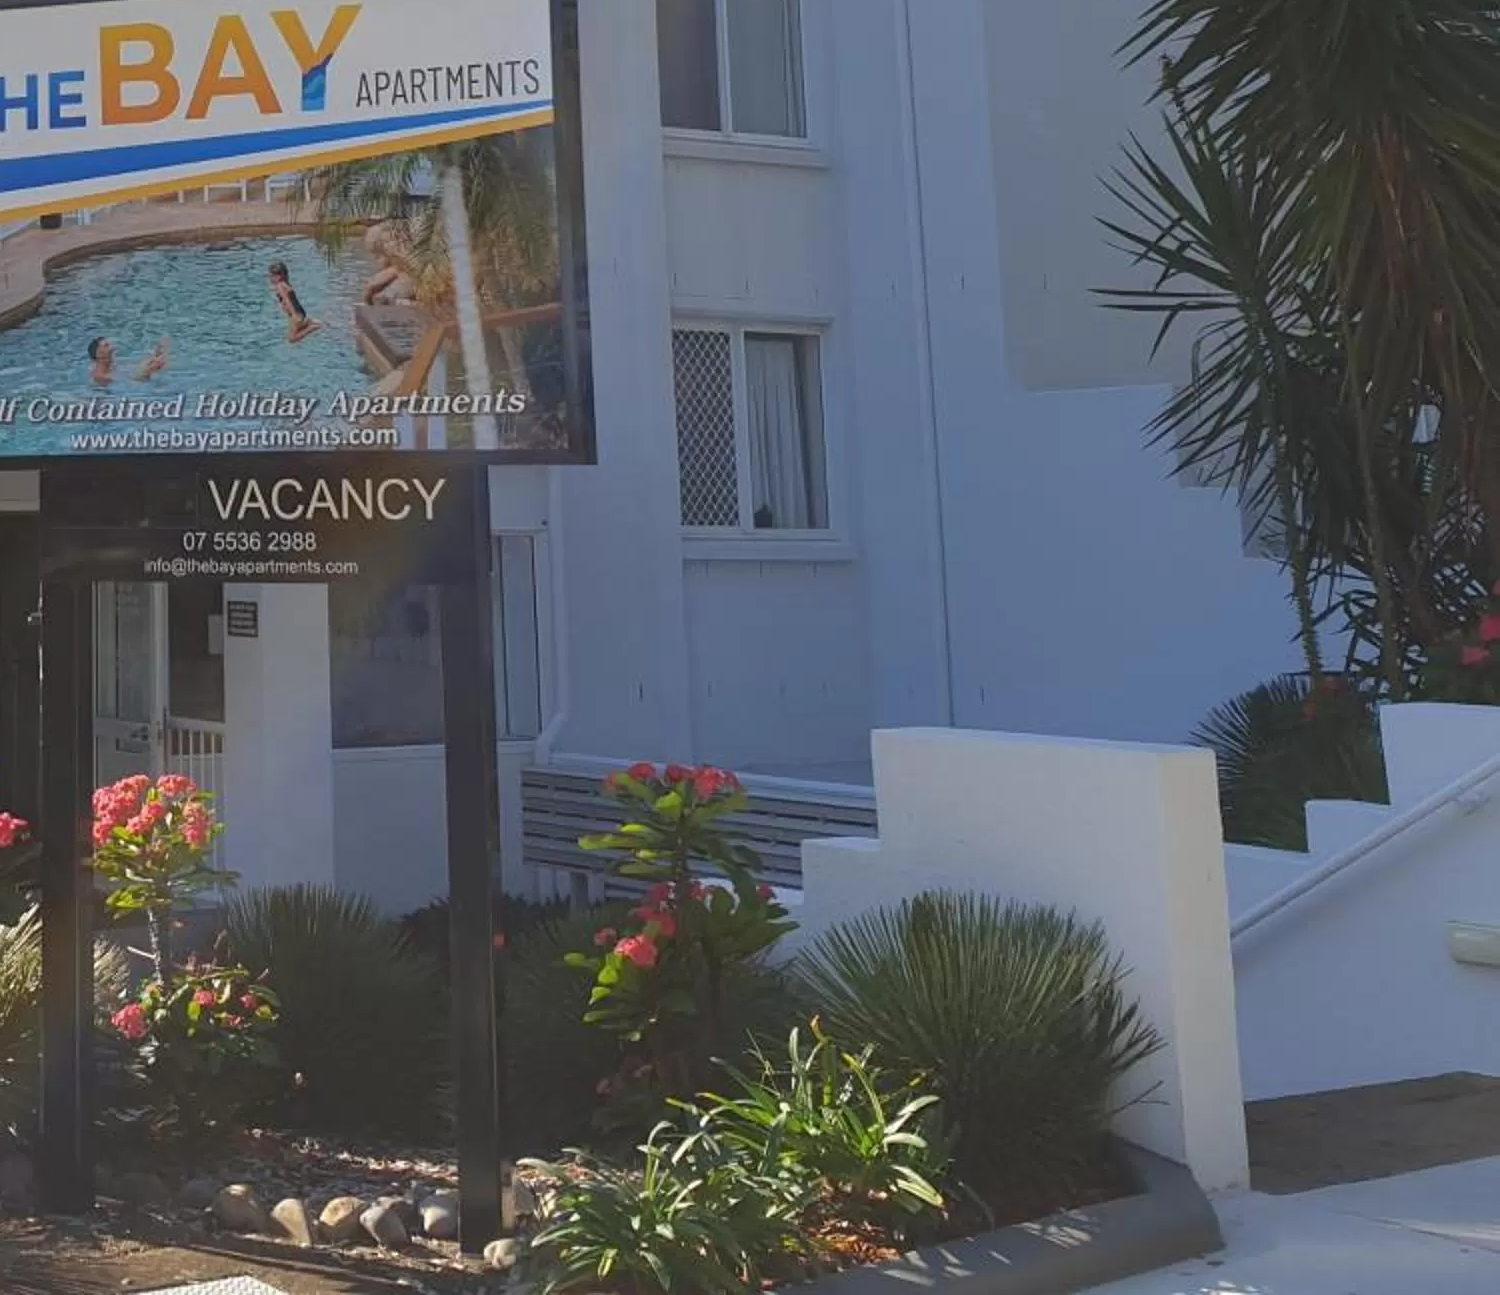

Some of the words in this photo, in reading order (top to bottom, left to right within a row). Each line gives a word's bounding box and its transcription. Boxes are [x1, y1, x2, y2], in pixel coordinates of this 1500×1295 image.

[100, 3, 363, 126] BAY
[354, 59, 541, 108] APARTMENTS
[26, 393, 184, 424] Contained
[194, 390, 317, 425] Holiday
[325, 387, 527, 423] Apartments
[70, 425, 399, 452] www.thebayapartments.com
[207, 478, 447, 521] VACANCY
[182, 532, 206, 552] 07
[212, 531, 262, 552] 5536
[266, 531, 318, 552] 2988
[143, 555, 360, 578] info@thebayapartments.com
